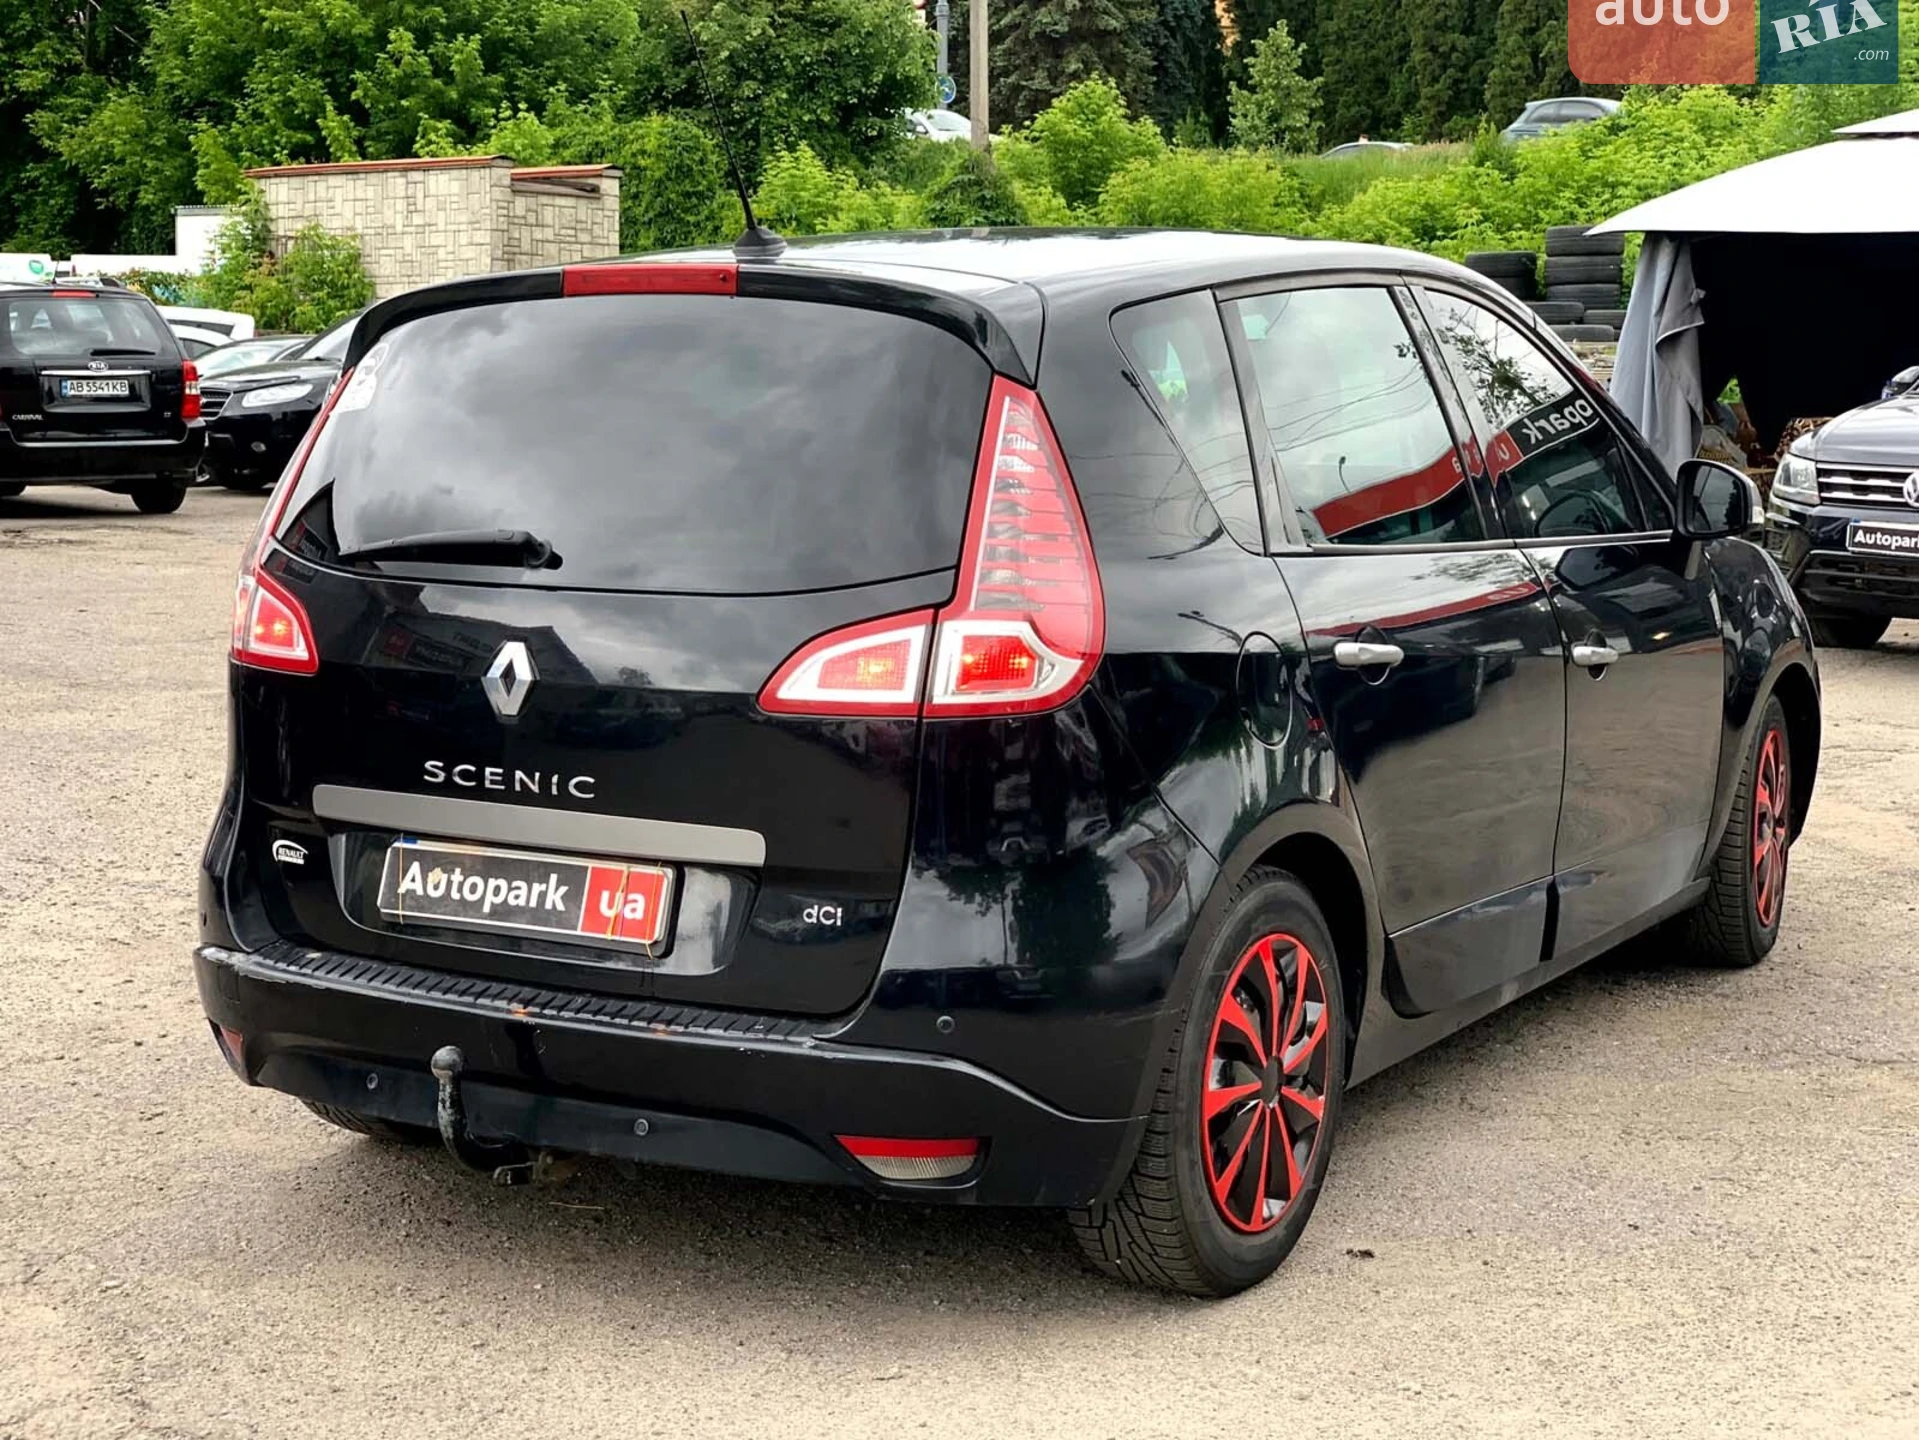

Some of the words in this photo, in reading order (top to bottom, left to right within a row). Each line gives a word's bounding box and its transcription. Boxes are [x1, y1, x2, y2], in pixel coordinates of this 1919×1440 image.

[1853, 529, 1919, 550] Autopar
[423, 760, 596, 799] SCENIC
[397, 860, 569, 913] Autopark
[599, 889, 646, 920] ua
